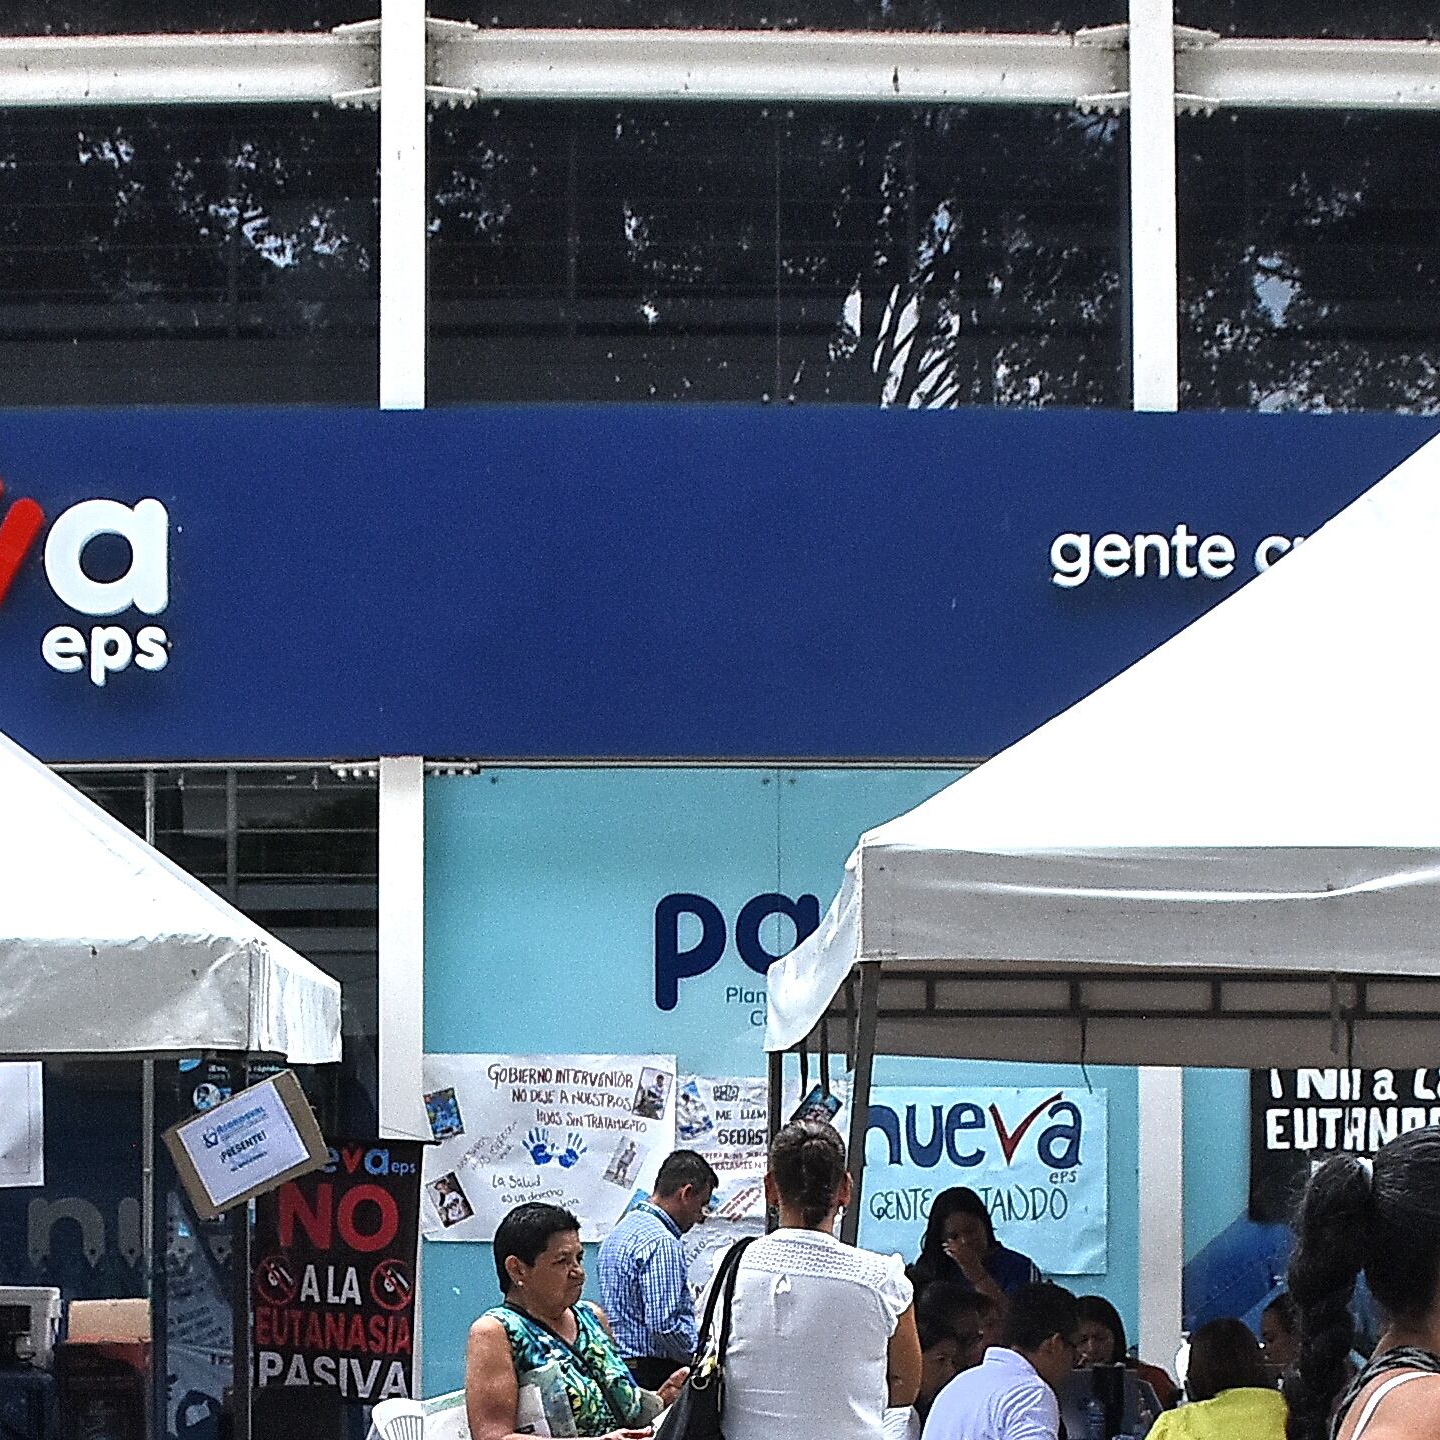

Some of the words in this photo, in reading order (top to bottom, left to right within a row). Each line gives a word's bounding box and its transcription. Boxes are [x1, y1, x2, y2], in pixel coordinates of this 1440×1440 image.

[1049, 524, 1235, 588] gente
[1254, 535, 1306, 573] c
[41, 624, 168, 686] eps
[726, 986, 767, 1004] Plan
[487, 1063, 553, 1089] GOBIERNO
[1373, 1068, 1399, 1101] a
[512, 1089, 528, 1103] NO
[559, 1089, 569, 1104] A
[571, 1091, 633, 1113] NUESTROS
[715, 1109, 732, 1121] ME
[861, 1091, 1083, 1170] nueva
[391, 1156, 417, 1175] eps
[278, 1183, 399, 1252] NO
[869, 1188, 935, 1221] GENTE
[979, 1184, 1069, 1222] TANDO
[300, 1264, 321, 1303] A
[327, 1265, 362, 1306] LA
[256, 1306, 411, 1354] EUTANASIA
[258, 1351, 409, 1399] PASIVA
